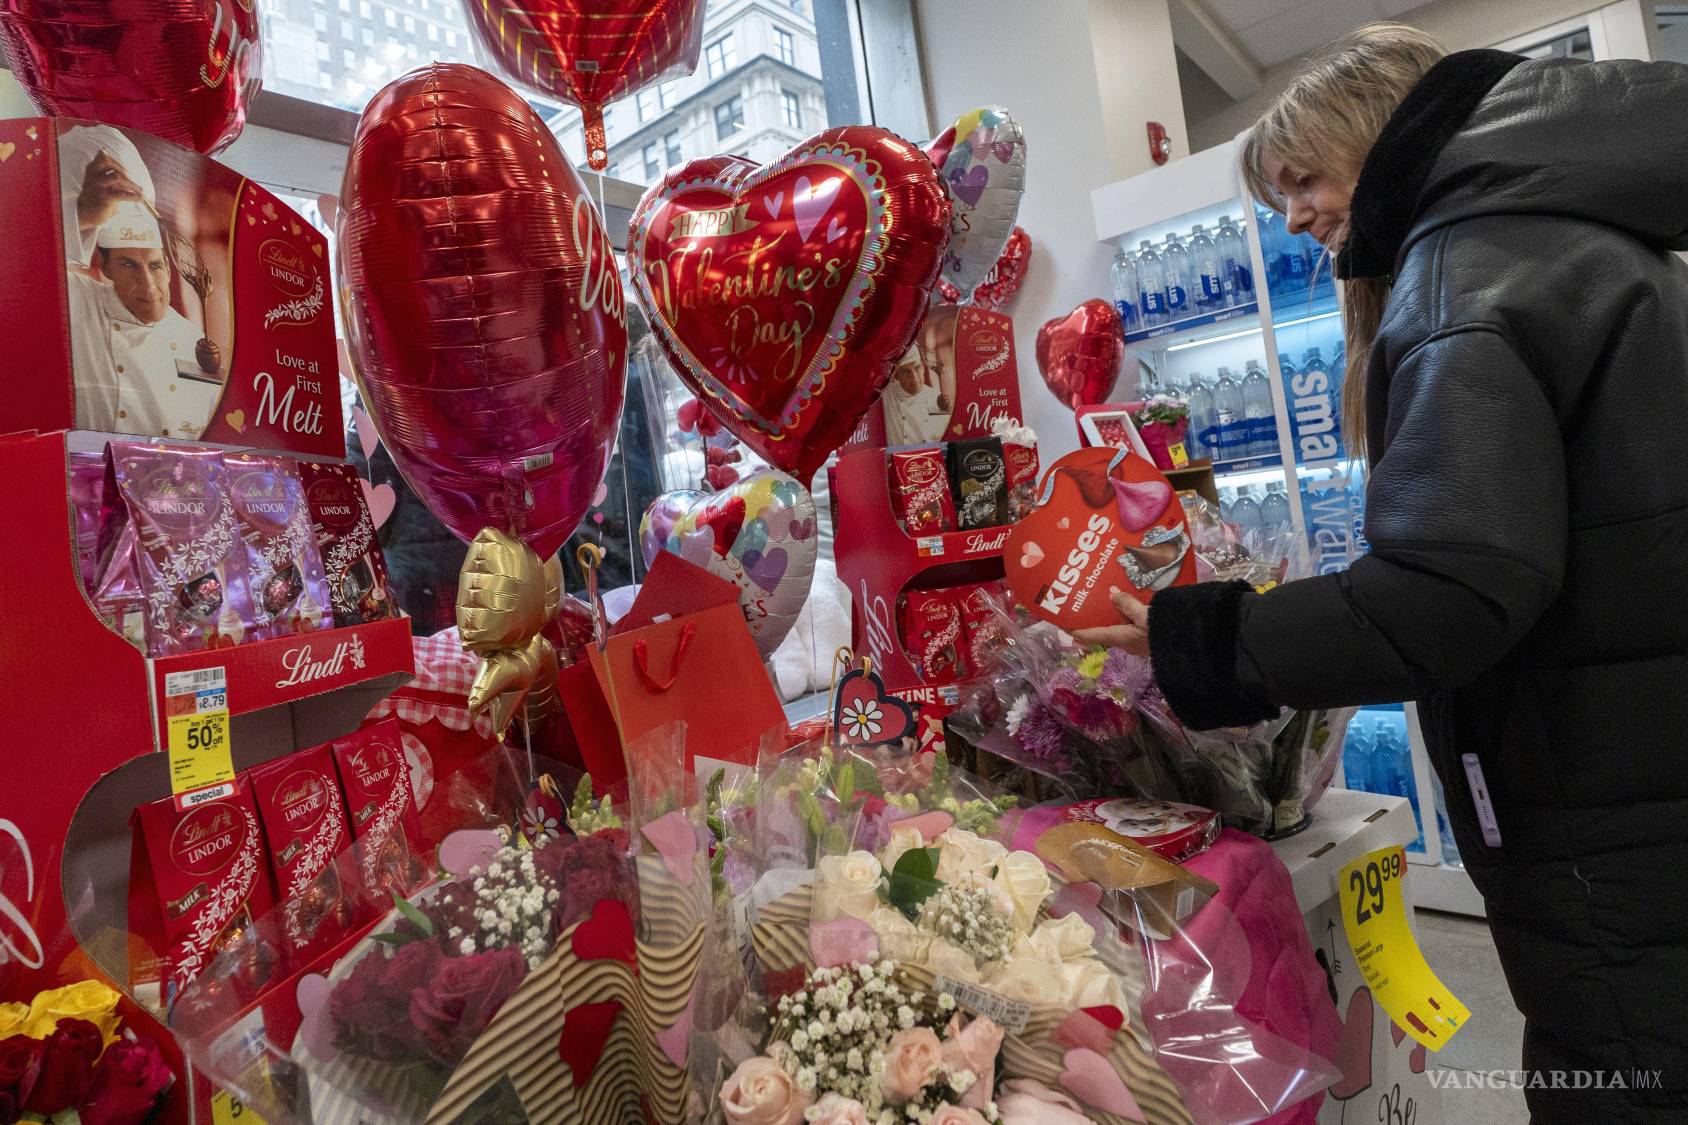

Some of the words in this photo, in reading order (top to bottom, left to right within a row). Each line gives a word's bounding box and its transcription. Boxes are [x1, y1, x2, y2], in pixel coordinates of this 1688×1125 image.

[679, 211, 738, 236] HAPPY
[271, 266, 305, 287] LINDOR
[650, 230, 850, 329] Valentine's
[726, 301, 815, 381] Day
[276, 348, 306, 371] Love
[308, 360, 320, 374] at
[296, 374, 322, 395] First
[980, 388, 997, 397] Love
[999, 388, 1007, 396] at
[253, 371, 323, 435] Melt
[991, 398, 1009, 407] First
[246, 503, 286, 514] LINDOR
[320, 504, 352, 515] LINDOR
[963, 532, 1007, 553] Lindt
[1071, 588, 1089, 613] milk
[1085, 537, 1118, 588] chocolate
[276, 642, 348, 689] Lindt
[212, 735, 223, 745] off
[362, 768, 390, 787] LINDOR
[190, 786, 225, 803] special
[284, 797, 319, 822] LINDOR
[360, 806, 372, 821] MILK
[188, 835, 233, 864] LINDOR
[282, 842, 297, 862] MILK
[179, 889, 200, 913] MILK
